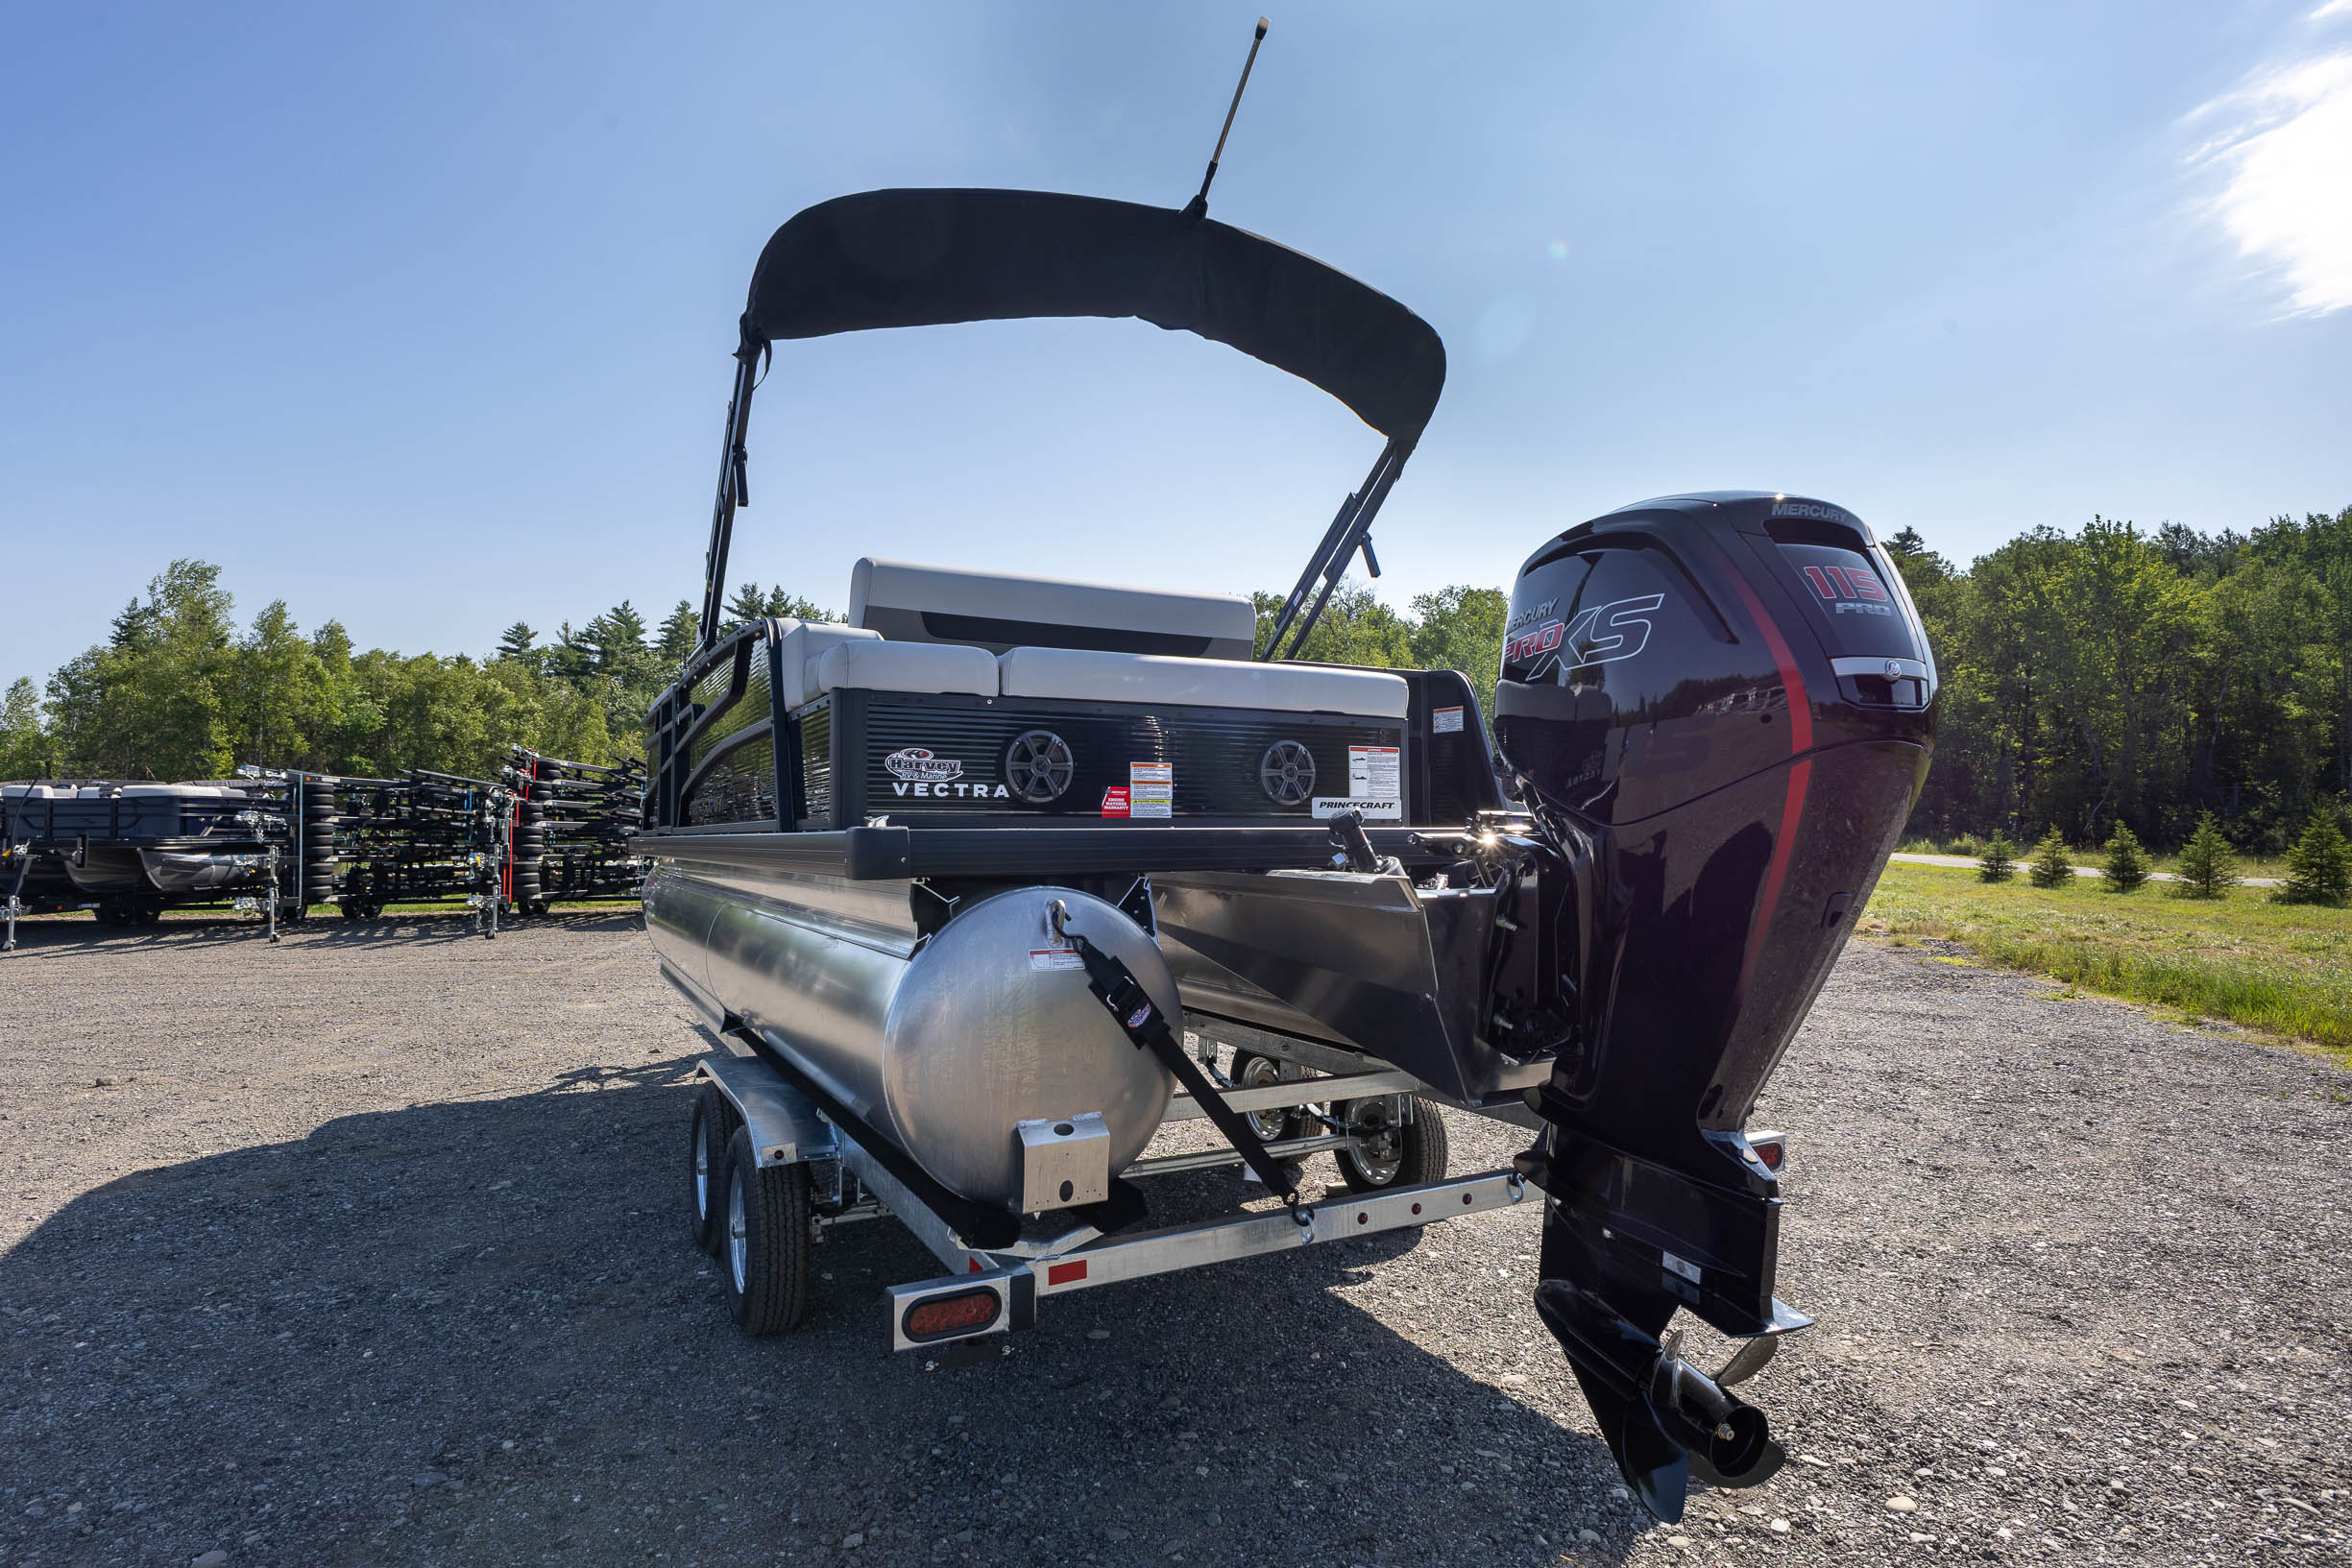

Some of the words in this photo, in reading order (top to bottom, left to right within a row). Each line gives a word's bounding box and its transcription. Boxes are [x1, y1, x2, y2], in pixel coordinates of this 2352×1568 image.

[1772, 503, 1847, 521] MERCURY
[1804, 567, 1888, 602] 115
[1835, 602, 1891, 615] PRO
[1525, 592, 1665, 682] XS
[890, 758, 959, 773] Harvey
[921, 771, 947, 780] Marine
[892, 783, 1009, 797] VECTRA
[1320, 801, 1395, 809] PRINCECRAFT
